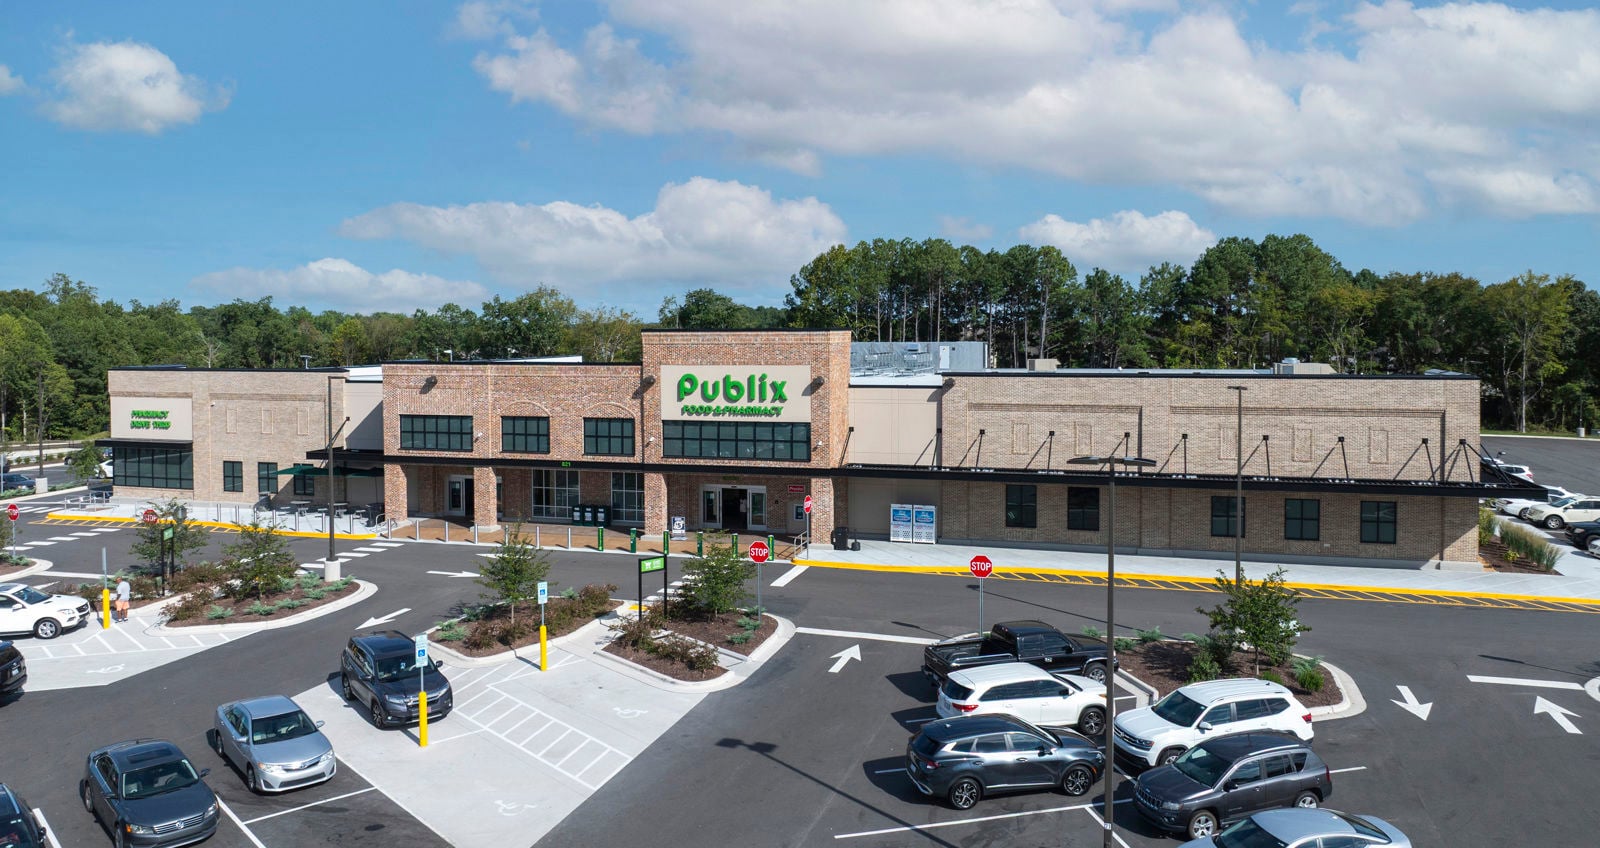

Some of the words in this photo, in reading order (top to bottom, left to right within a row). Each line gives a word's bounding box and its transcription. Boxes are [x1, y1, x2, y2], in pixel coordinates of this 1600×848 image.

[678, 373, 788, 402] Publix
[131, 410, 169, 419] PHARMACY
[682, 405, 713, 415] FOOD
[713, 405, 724, 416] &
[724, 406, 784, 417] PHARMACY
[130, 421, 151, 429] DRIVE
[750, 548, 768, 556] STOP
[971, 562, 991, 571] STOP
